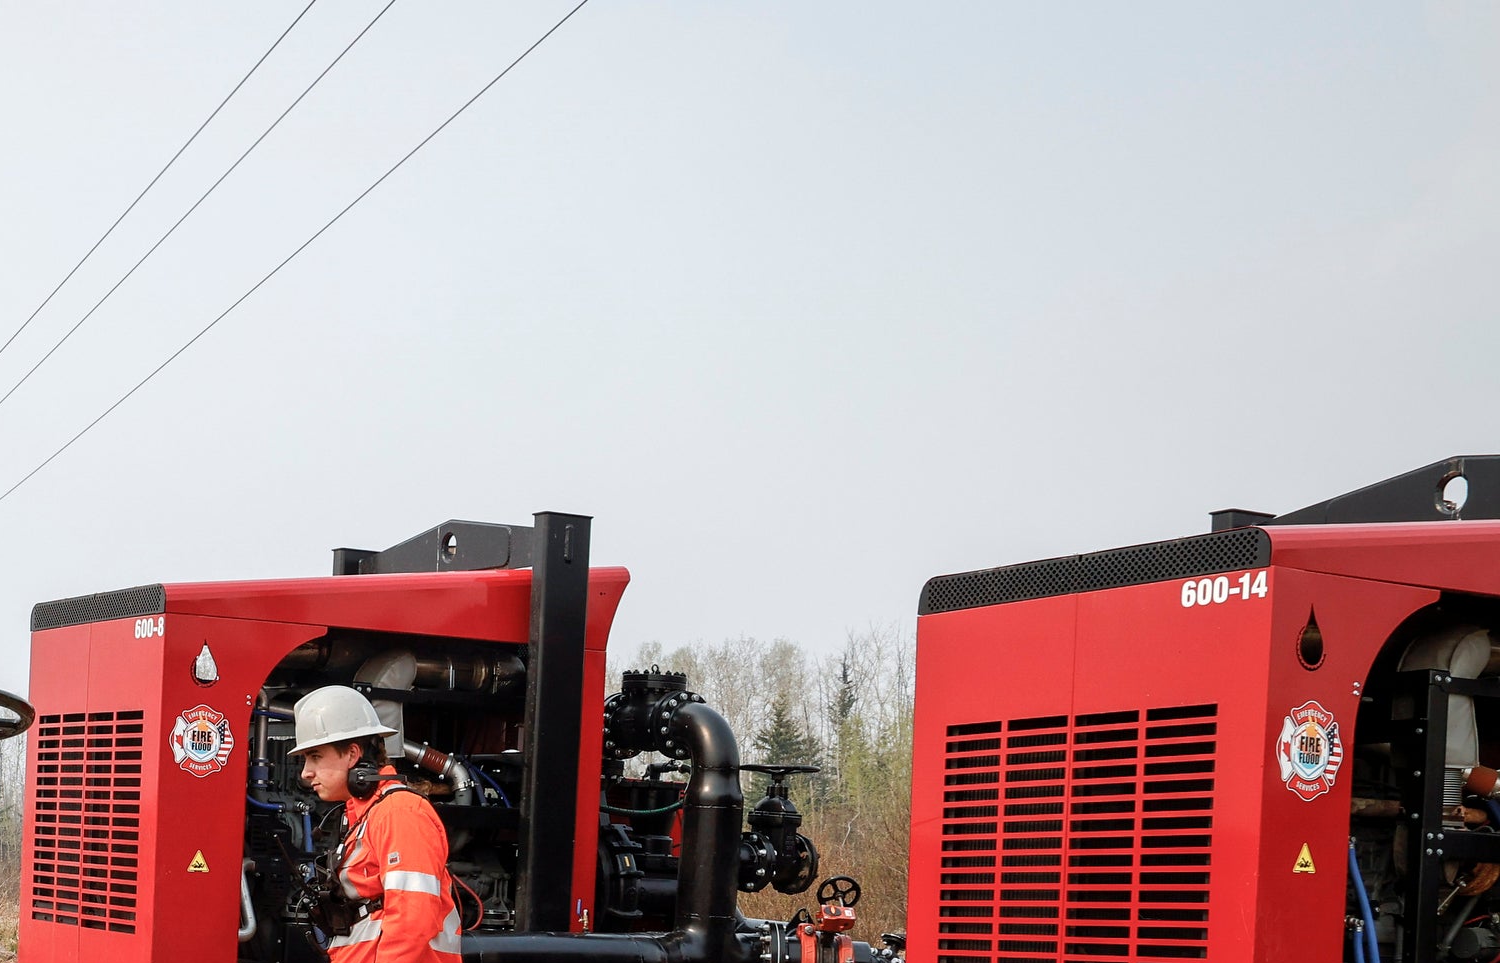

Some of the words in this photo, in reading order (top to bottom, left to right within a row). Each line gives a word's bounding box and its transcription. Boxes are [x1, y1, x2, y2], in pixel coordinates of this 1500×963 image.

[1181, 570, 1268, 608] 600-14
[135, 616, 165, 639] 600-8
[192, 730, 212, 742] FIRE
[1300, 735, 1320, 752] FIRE
[191, 742, 212, 751] FLOOD
[1299, 752, 1320, 765] FLOOD
